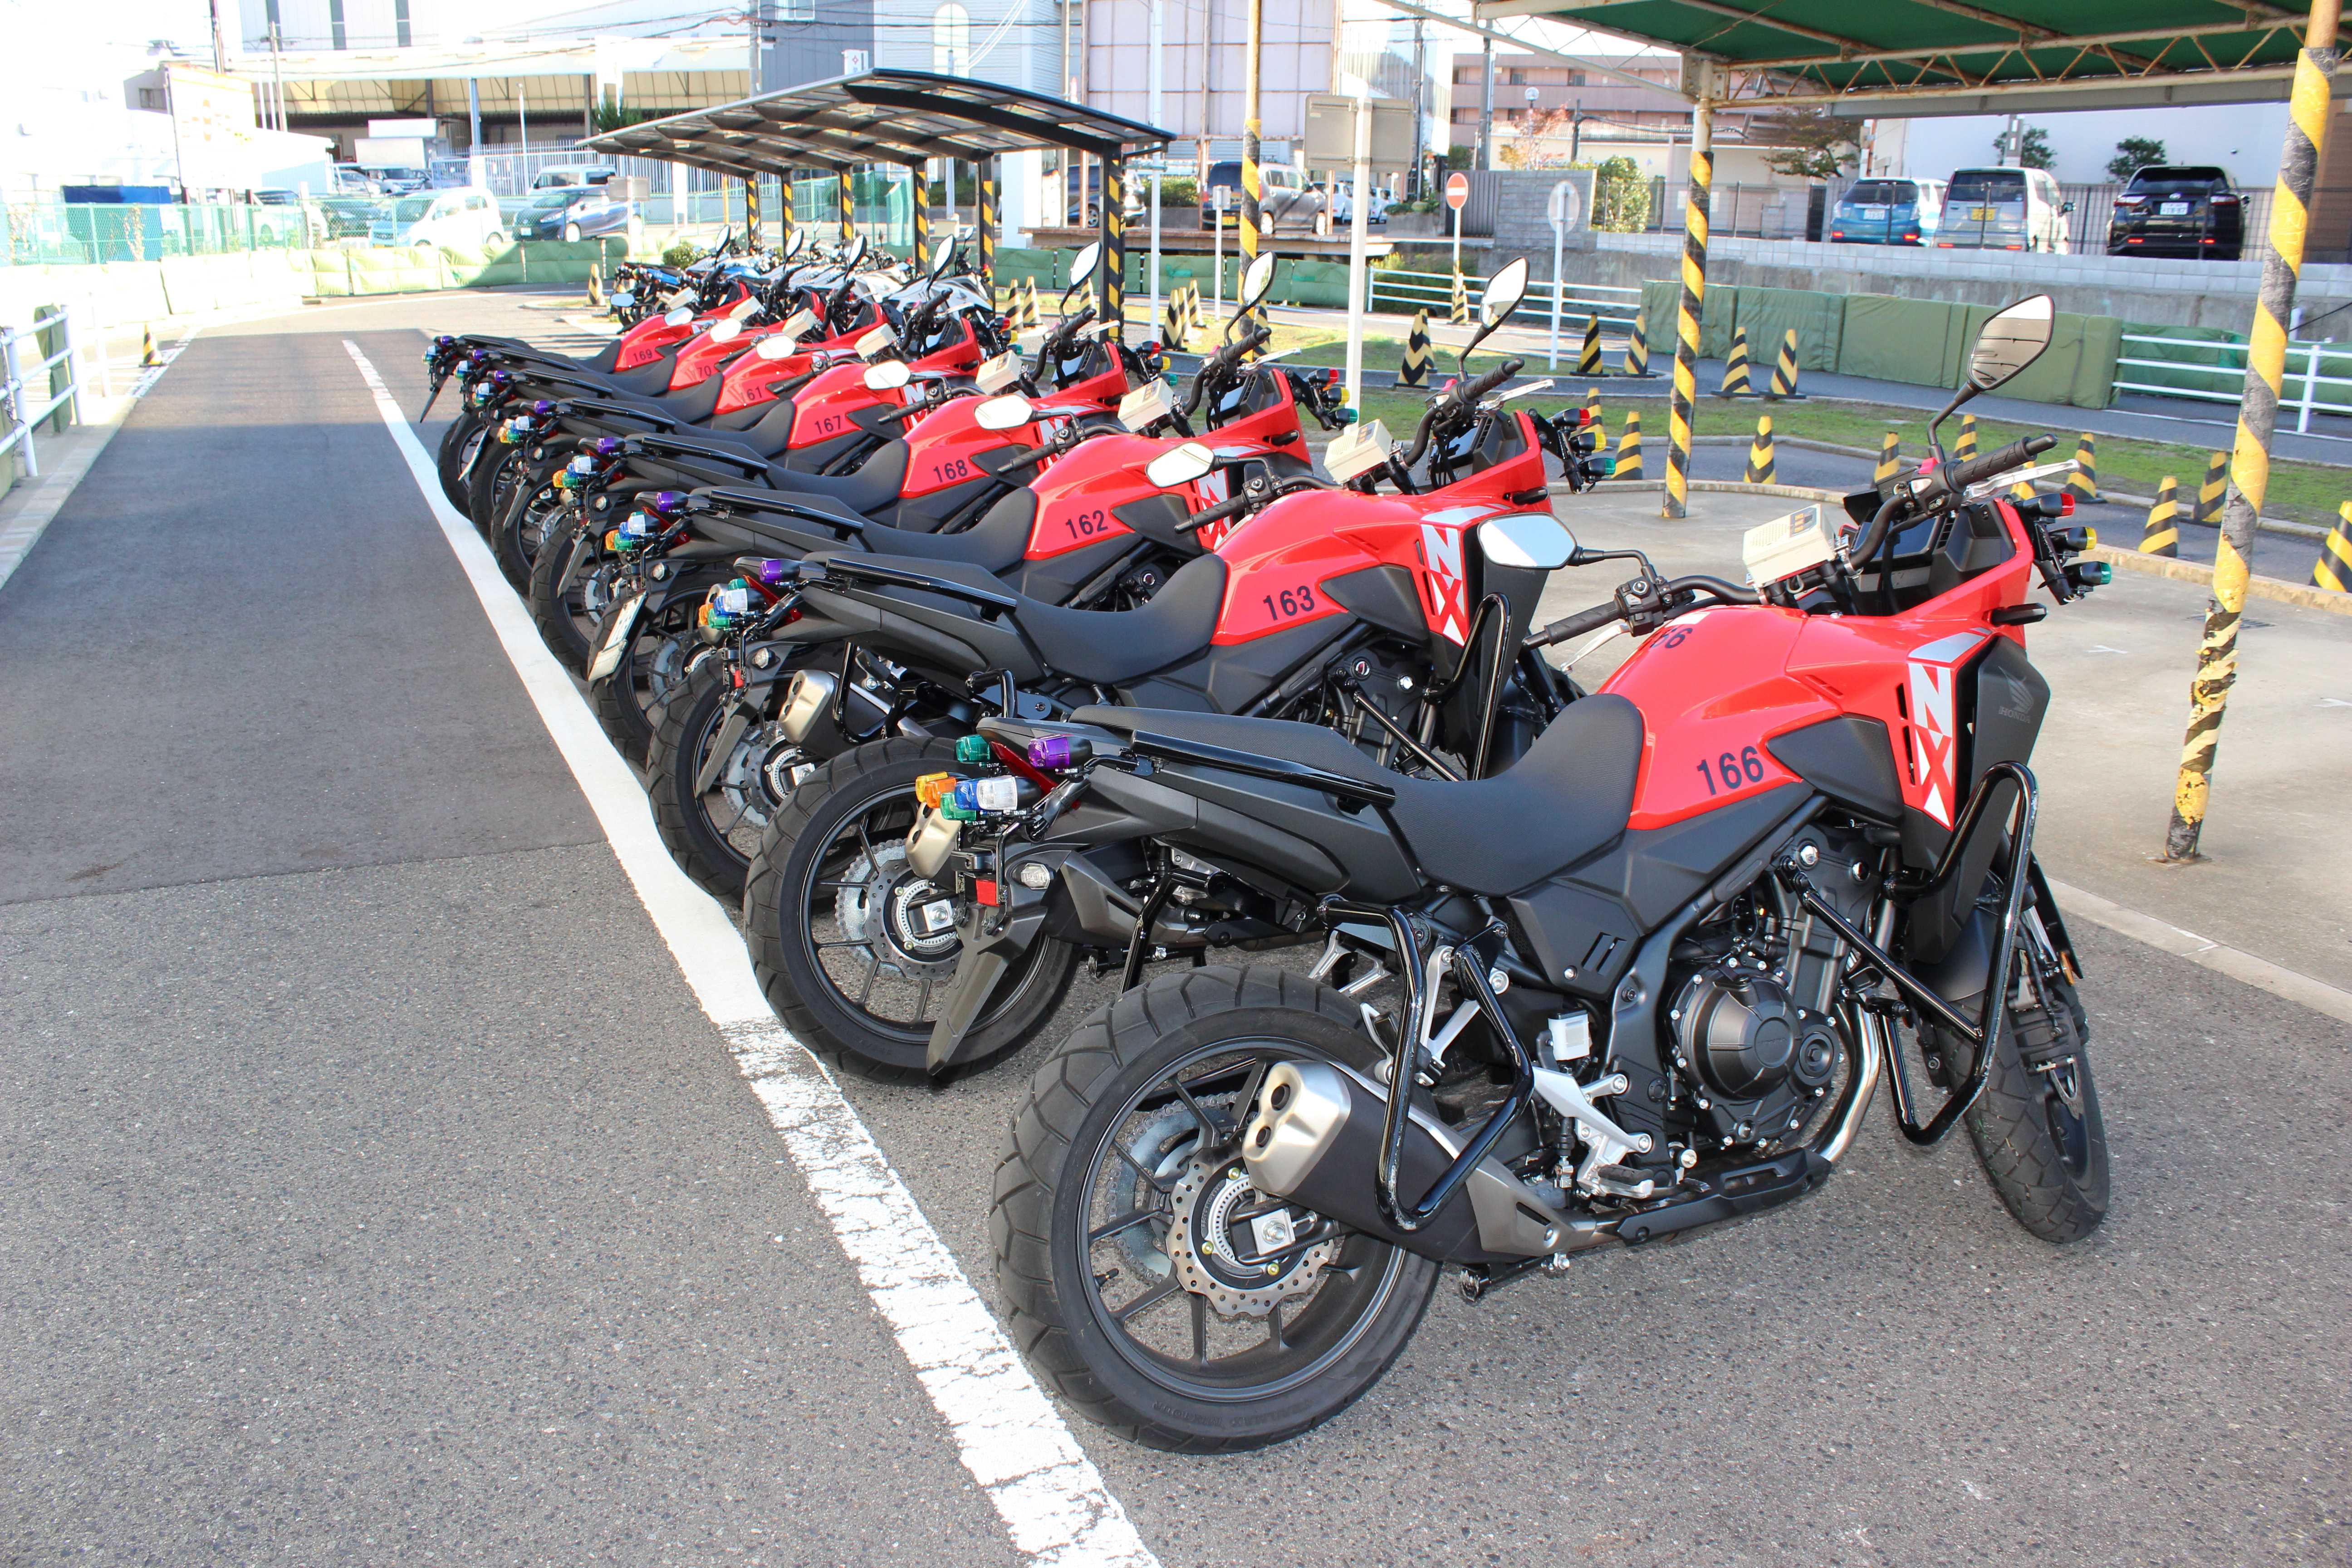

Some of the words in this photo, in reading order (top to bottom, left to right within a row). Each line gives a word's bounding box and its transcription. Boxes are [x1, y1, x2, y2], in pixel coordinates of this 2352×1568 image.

[633, 349, 652, 363] 169
[814, 416, 843, 435] 167
[933, 459, 968, 484] 168
[1065, 510, 1108, 539] 162
[1262, 585, 1315, 621] 163
[1998, 706, 2032, 724] HONDA
[1908, 663, 1953, 828] NX
[1696, 745, 1764, 795] 166
